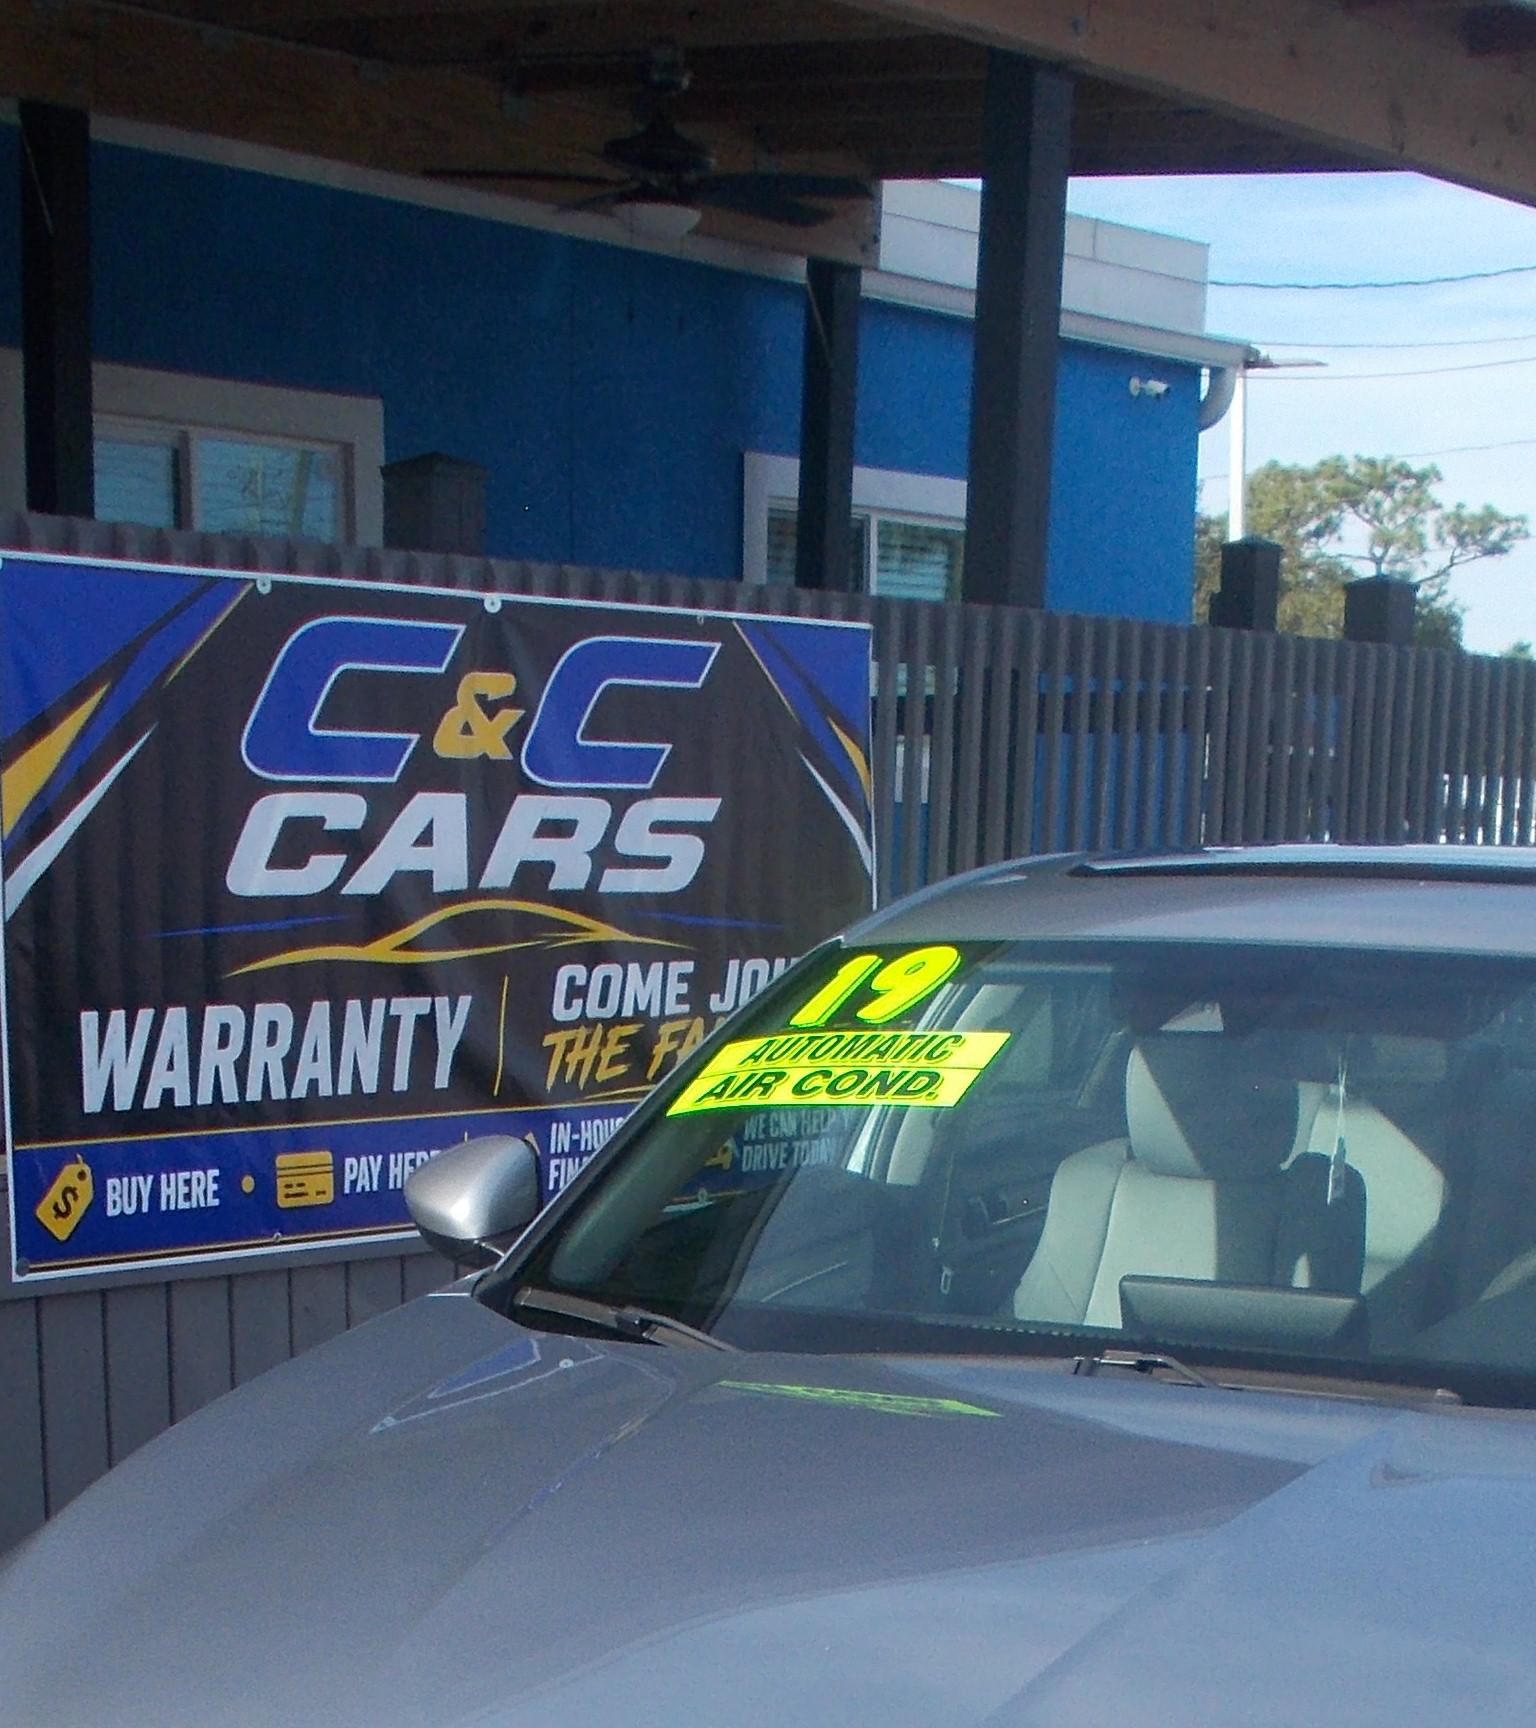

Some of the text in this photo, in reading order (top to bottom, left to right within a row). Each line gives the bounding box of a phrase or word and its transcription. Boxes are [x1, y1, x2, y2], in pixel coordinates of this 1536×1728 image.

[241, 615, 722, 790] C&C
[225, 792, 723, 897] CARS
[552, 957, 802, 1022] COME JO
[788, 945, 962, 1029] 19
[80, 995, 472, 1113] WARRANTY
[541, 1016, 726, 1094] THE FA
[738, 1033, 964, 1067] AUTOMATIC
[693, 1068, 944, 1105] AIR COND.
[550, 1116, 625, 1154] IN-HOU
[744, 1112, 767, 1141] WE
[344, 1149, 442, 1195] PAY HE
[548, 1156, 590, 1191] FIN
[741, 1141, 788, 1172] DRIVE
[106, 1168, 220, 1217] BUY HERE
